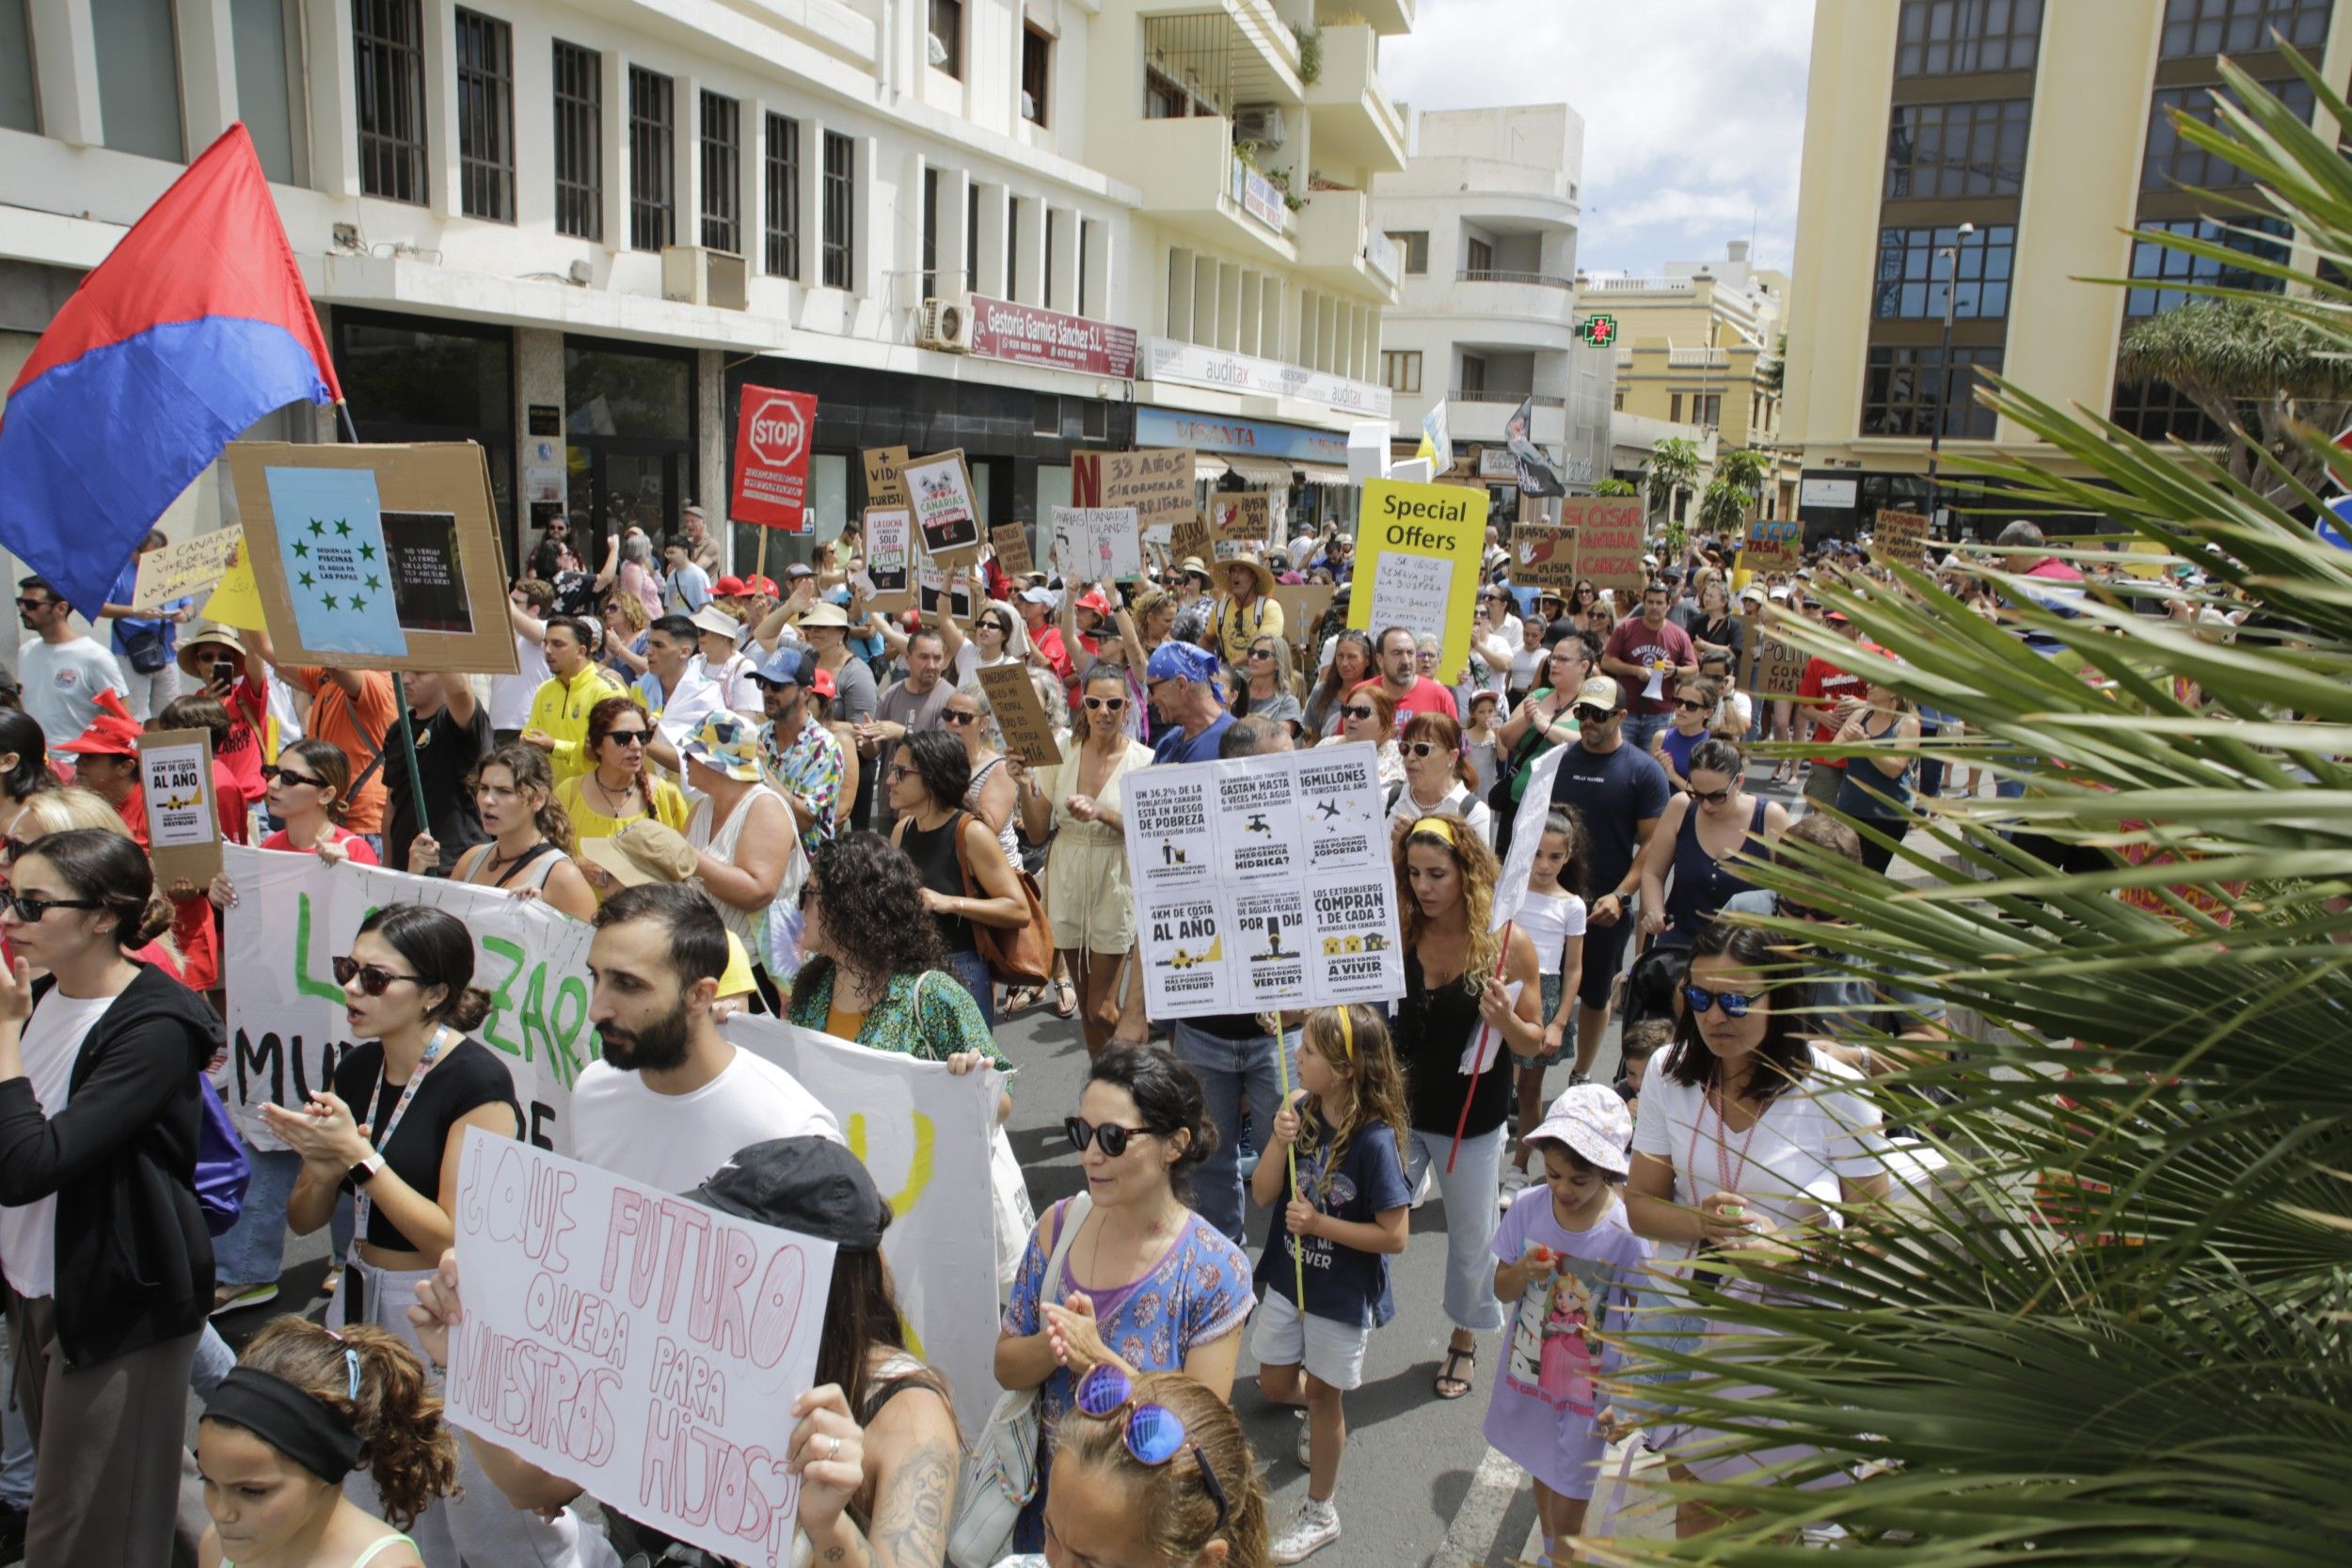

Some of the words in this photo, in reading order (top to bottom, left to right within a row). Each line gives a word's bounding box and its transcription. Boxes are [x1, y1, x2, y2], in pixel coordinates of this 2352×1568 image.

[988, 305, 1024, 337] Gestoría
[1026, 312, 1057, 343] Garnica
[1058, 319, 1089, 350] Sánchez
[1206, 356, 1249, 385] auditax
[1331, 383, 1361, 406] auditax
[755, 419, 799, 447] STOP
[1176, 420, 1256, 447] VISANTA
[1111, 458, 1134, 481] 33
[870, 493, 904, 506] TURIST
[920, 495, 964, 513] CANARIAS
[1383, 494, 1467, 523] Special
[874, 519, 882, 528] LA
[883, 518, 903, 528] LUCHA
[1089, 511, 1129, 523] CANARY
[1247, 514, 1263, 525] YA!
[1565, 507, 1583, 526] SI
[1090, 521, 1129, 534] ISLANDS
[1753, 522, 1797, 542] ECO
[1877, 523, 1886, 531] NO
[879, 535, 898, 545] SOLO
[1385, 524, 1456, 552] Offers
[1559, 529, 1575, 540] YA!
[1580, 531, 1637, 550] VANTARA
[873, 544, 881, 552] EL
[1747, 540, 1779, 553] TASA
[1890, 537, 1912, 547] AMA
[874, 552, 903, 566] SALVA
[1382, 566, 1418, 580] RESERVA
[1515, 573, 1539, 583] TIENE
[154, 775, 168, 789] AL
[173, 771, 198, 788] AÑO
[1227, 776, 1252, 784] CANARIAS
[1264, 770, 1289, 779] TURISTAS
[1136, 790, 1147, 800] UN
[1179, 785, 1189, 795] DE
[1192, 784, 1202, 793] LA
[1220, 782, 1256, 796] GASTAN
[1259, 778, 1290, 791] HASTA
[1311, 785, 1342, 796] TURISTAS
[1354, 782, 1368, 790] AÑO
[1136, 798, 1172, 807] POBLACIÓN
[1174, 795, 1202, 804] CANARIA
[1221, 797, 1227, 805] 6
[1229, 794, 1249, 804] VECES
[1270, 789, 1291, 799] AGUA
[1263, 799, 1292, 807] RESIDENTE
[1137, 805, 1157, 818] ESTÁ
[1159, 807, 1170, 816] EN
[1172, 803, 1203, 815] RIESGO
[1139, 819, 1152, 831] DE
[1155, 814, 1205, 828] POBREZA
[1152, 828, 1184, 837] EXCLUSIÓN
[1330, 839, 1367, 848] PODEMOS
[1234, 848, 1288, 860] EMERGENCIA
[1314, 846, 1368, 857] SOPORTAR?
[1313, 889, 1327, 898] LOS
[1328, 883, 1383, 896] EXTRANJEROS
[1248, 898, 1274, 907] MILLONES
[1248, 905, 1272, 915] AGUAS
[1273, 902, 1301, 912] FECALES
[1314, 892, 1384, 912] COMPRAN
[1152, 910, 1170, 920] 4KM
[1173, 908, 1185, 918] DE
[1187, 905, 1214, 917] COSTA
[1317, 913, 1323, 925] 1
[1327, 911, 1343, 924] DE
[1345, 909, 1375, 922] CADA
[1378, 908, 1386, 919] 3
[1239, 917, 1263, 931] POR
[1282, 910, 1303, 927] DÍA
[1317, 924, 1347, 933] VIVIENDAS
[1358, 920, 1387, 929] CANARIAS
[1153, 923, 1174, 942] AL
[1179, 916, 1216, 939] AÑO
[1266, 969, 1302, 977] PODEMOS
[1328, 965, 1339, 975] A
[1343, 960, 1382, 974] VIVIR
[1180, 975, 1214, 984] PODEMOS
[1253, 975, 1302, 988] VERTER?
[1328, 973, 1382, 982] NOSOTRAS/OS?
[1165, 982, 1215, 992] DESTRUIR?
[461, 1136, 578, 1274] ¿QUE
[600, 1186, 806, 1370] FUTURO
[525, 1271, 630, 1370] QUEDA
[649, 1337, 726, 1428] PARA
[453, 1308, 623, 1468] NUESTROS
